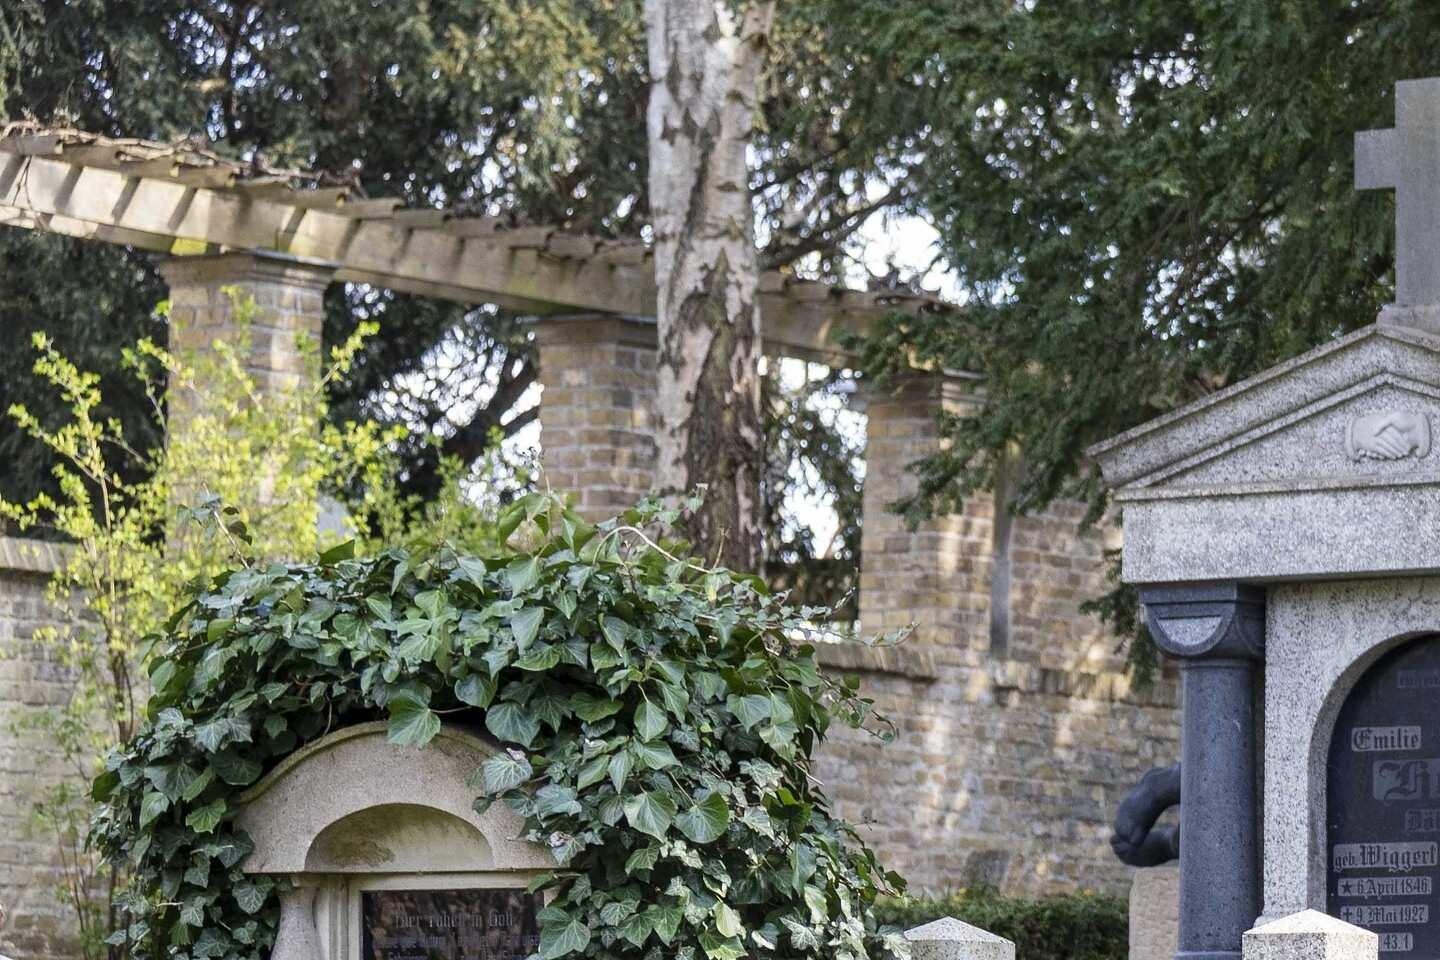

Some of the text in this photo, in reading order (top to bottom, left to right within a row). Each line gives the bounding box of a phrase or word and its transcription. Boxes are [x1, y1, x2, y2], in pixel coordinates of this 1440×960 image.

[1353, 727, 1420, 749] Emilie
[1359, 844, 1439, 872] Wiggert
[1365, 878, 1399, 899] April
